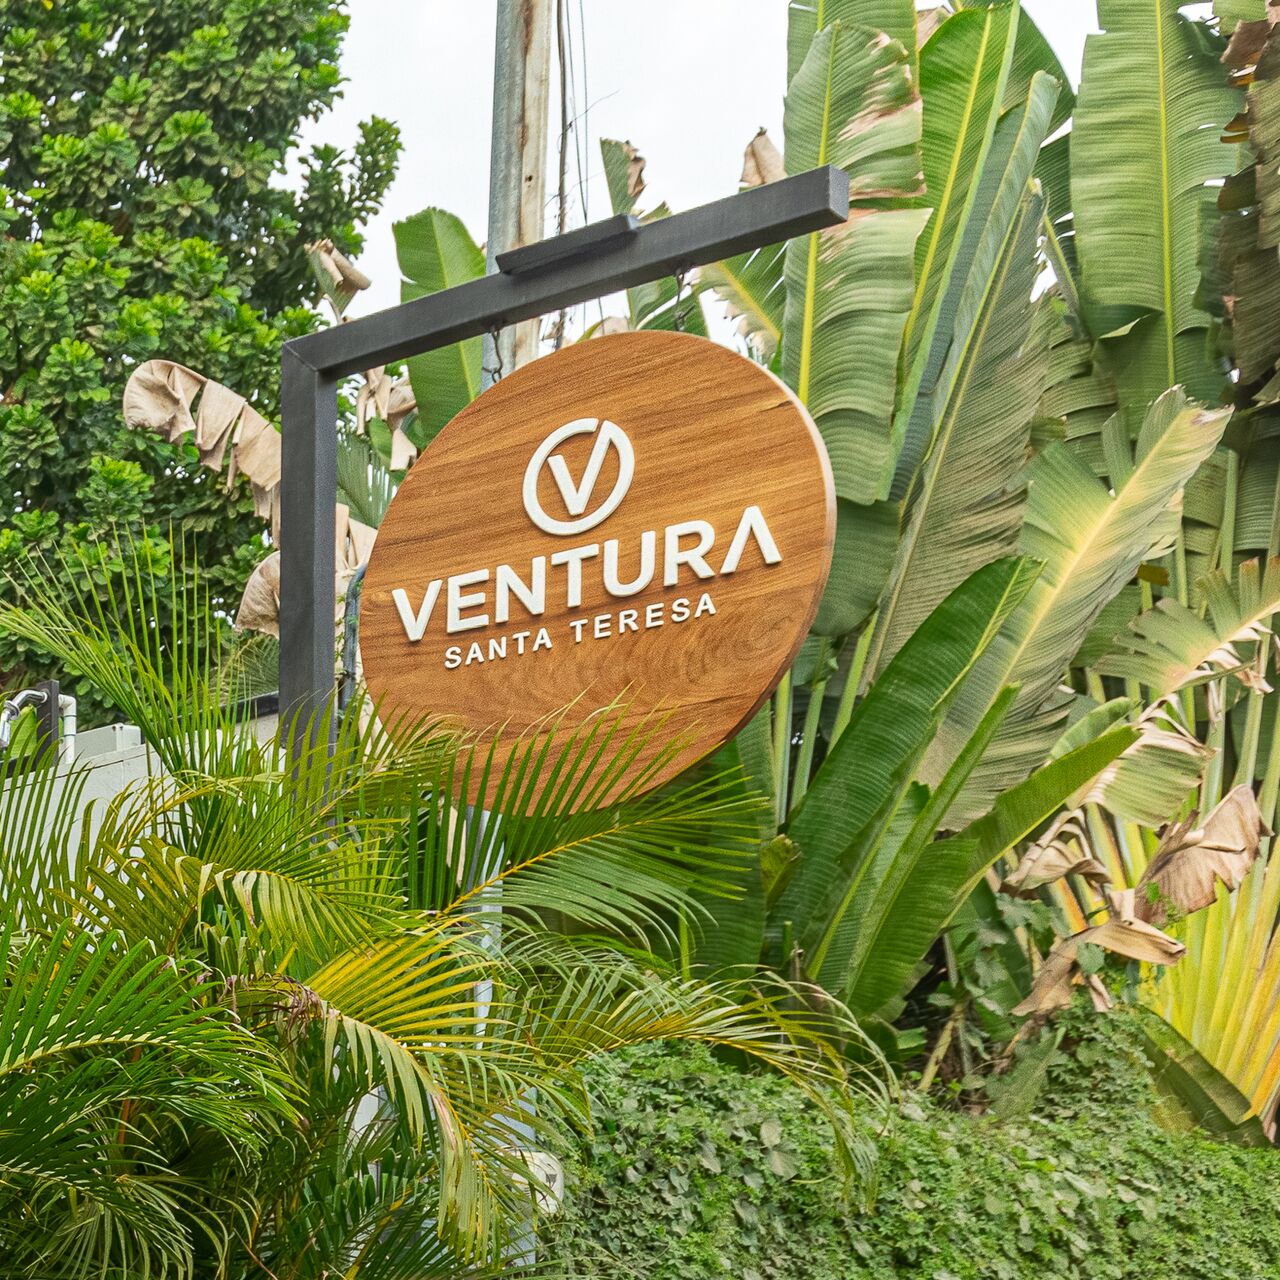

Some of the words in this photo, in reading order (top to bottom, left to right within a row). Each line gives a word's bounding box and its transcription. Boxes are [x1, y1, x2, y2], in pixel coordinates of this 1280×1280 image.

[392, 505, 783, 643] VENTURA
[444, 628, 553, 670] SANTA
[570, 593, 717, 643] TERESA
